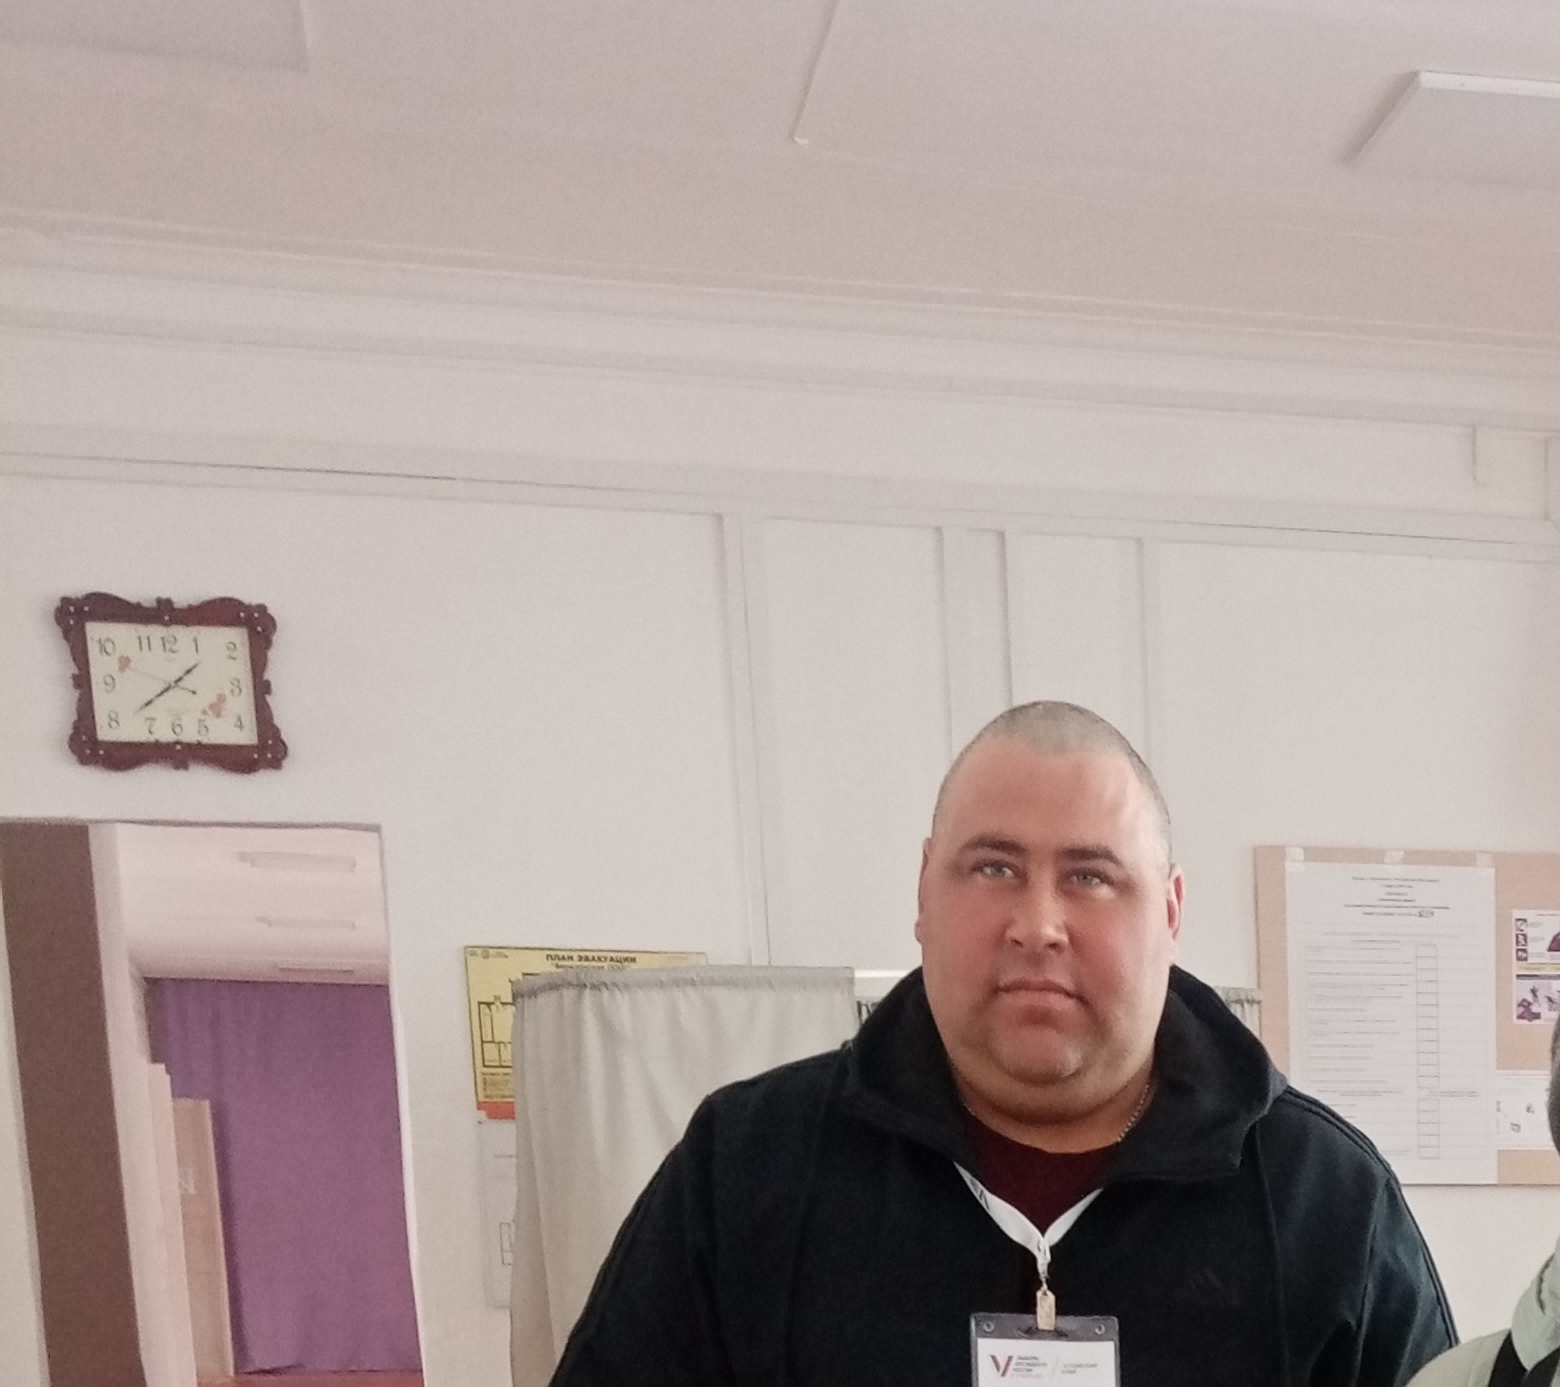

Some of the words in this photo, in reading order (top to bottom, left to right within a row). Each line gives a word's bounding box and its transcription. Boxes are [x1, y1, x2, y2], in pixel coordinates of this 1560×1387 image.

[98, 638, 115, 655] 10
[138, 635, 151, 651] 11
[160, 635, 178, 654] 12
[226, 641, 238, 660] 2
[103, 674, 116, 693] 9
[229, 677, 243, 697] 3
[107, 710, 120, 730] 8
[145, 716, 157, 735] 7
[171, 717, 183, 736] 6
[197, 717, 209, 736] 5
[234, 715, 244, 731] 4
[545, 953, 574, 962] ПЛАН
[577, 954, 637, 964] ЭВАКУАЦИИ
